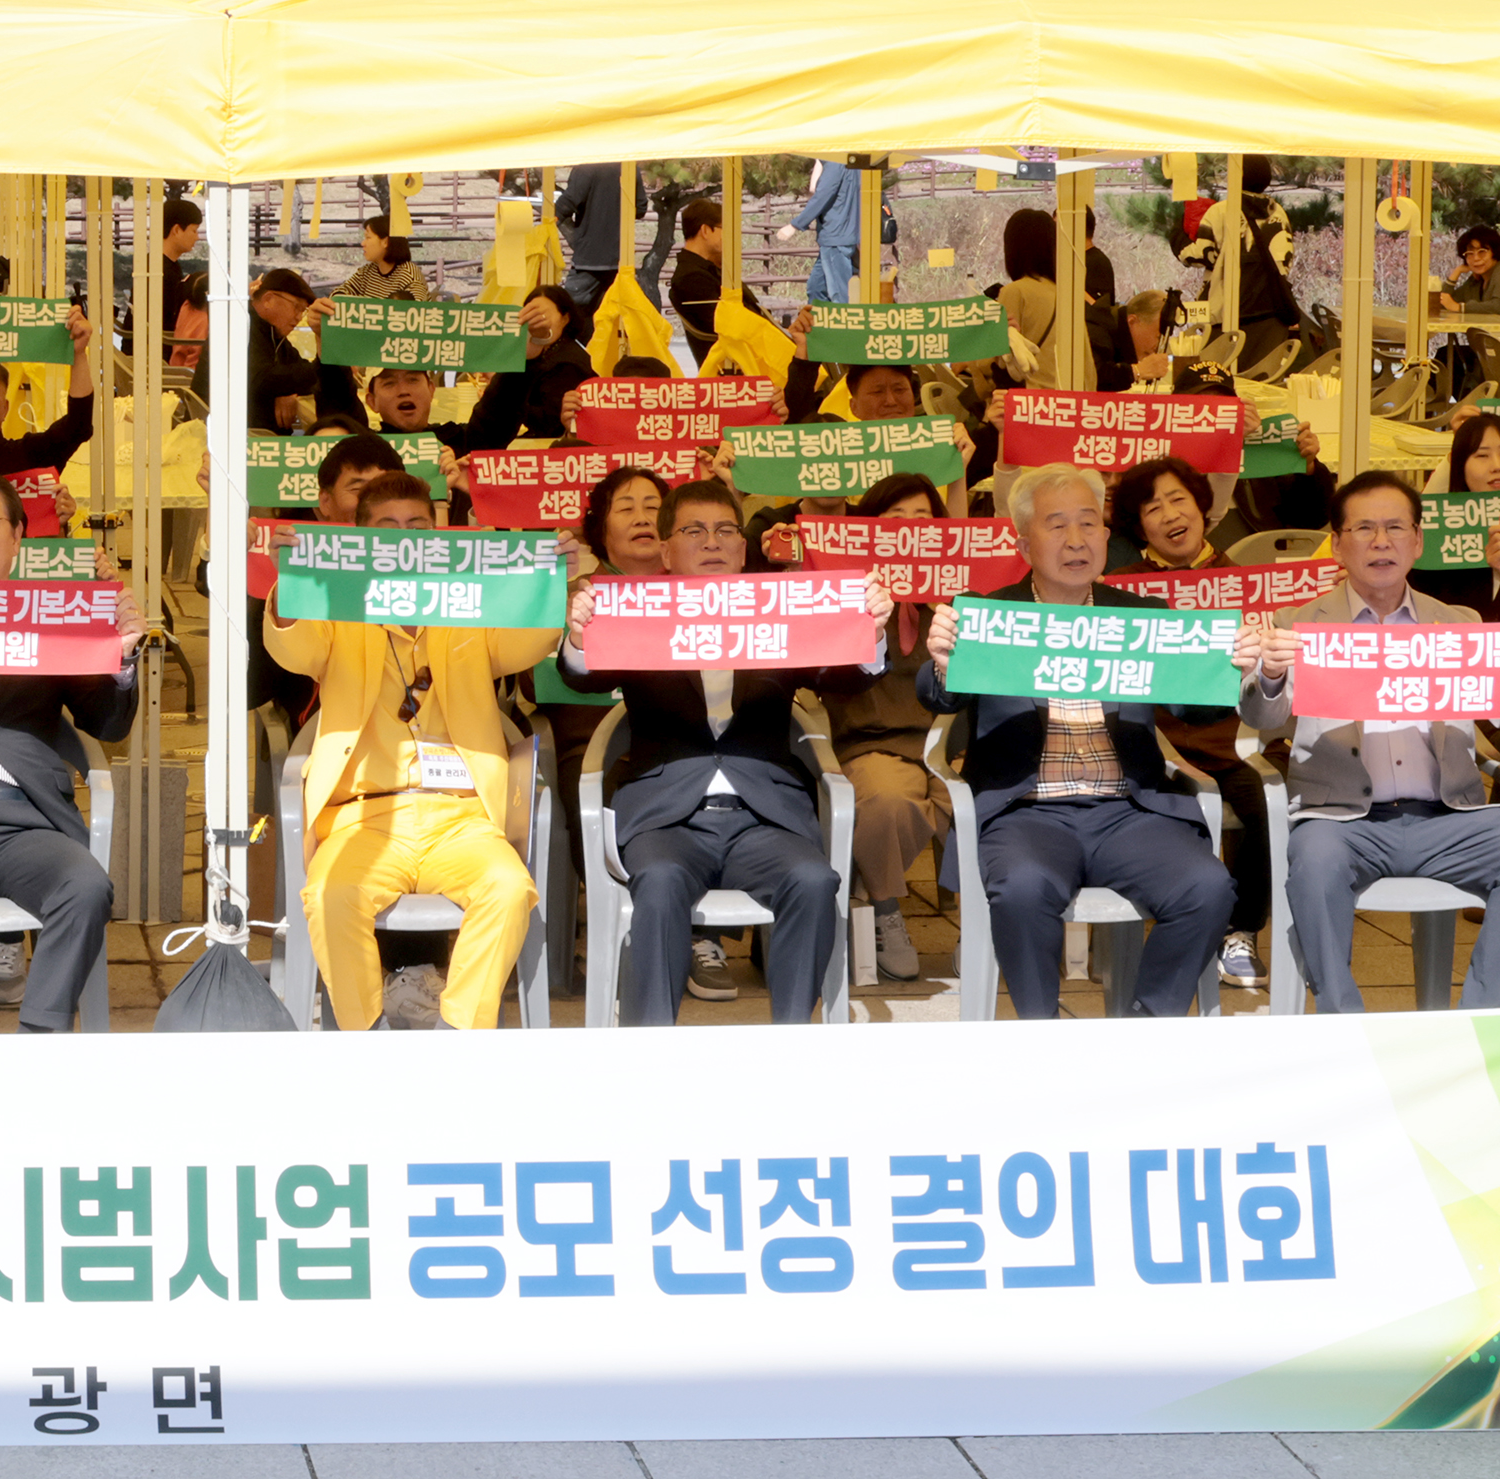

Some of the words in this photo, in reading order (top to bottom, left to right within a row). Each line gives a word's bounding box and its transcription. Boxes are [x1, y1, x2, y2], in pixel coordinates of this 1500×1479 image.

[0, 301, 69, 328] 기본소득
[327, 302, 384, 331] 괴산군
[387, 306, 444, 335] 농어촌
[447, 308, 521, 337] 기본소득
[812, 306, 865, 330] 괴산군
[868, 305, 925, 331] 농어촌
[927, 301, 1002, 328] 기본소득
[380, 337, 418, 364] 선정
[421, 340, 465, 367] 기원!
[865, 334, 903, 360] 선정
[906, 333, 949, 360] 기원!
[580, 383, 636, 409] 괴산군
[639, 382, 696, 409] 농어촌
[699, 380, 775, 407] 기본소득
[637, 415, 673, 440] 선정
[677, 414, 719, 440] 기원!
[1012, 395, 1077, 428] 괴산군
[1080, 399, 1146, 431] 농어촌
[1150, 402, 1239, 435] 기본소득
[246, 441, 280, 468] 산군
[284, 442, 334, 468] 농어
[392, 437, 440, 465] 소득
[730, 430, 796, 458] 괴산군
[799, 426, 864, 456] 농어촌
[869, 419, 955, 453] 기본소득
[1073, 435, 1116, 465] 선정
[474, 455, 539, 485] 괴산군
[543, 453, 607, 484] 농어촌
[798, 462, 841, 491] 선정
[278, 473, 320, 501] 선정
[538, 491, 581, 520] 선정
[288, 534, 366, 570] 괴산군
[371, 536, 450, 574] 농어촌
[456, 539, 559, 575] 기본소득
[801, 522, 870, 556] 괴산군
[873, 525, 943, 558] 농어촌
[947, 526, 1019, 558] 기본소
[1440, 534, 1484, 563] 선정
[9, 547, 96, 578] 기본소득
[873, 563, 913, 596] 선정
[918, 565, 969, 596] 기원!
[364, 580, 417, 616] 선정
[422, 581, 482, 618] 기원!
[594, 582, 671, 617] 괴산군
[676, 581, 755, 617] 농어촌
[761, 578, 866, 615] 기본소득
[1174, 574, 1243, 610] 농어촌
[1248, 566, 1339, 605] 기본소득
[13, 588, 116, 625] 기본소득
[670, 624, 722, 661] 선정
[728, 623, 788, 660] 기원!
[959, 607, 1040, 647] 괴산군
[1044, 613, 1125, 652] 농어촌
[1129, 618, 1237, 656] 기본소득
[1303, 633, 1378, 668] 괴산군
[1384, 632, 1462, 668] 농어촌
[1033, 655, 1087, 693] 선정
[1092, 659, 1154, 695] 기원!
[1377, 676, 1428, 712] 선정
[1435, 676, 1493, 711] 기원!
[406, 1160, 616, 1299] 공모
[650, 1156, 855, 1295] 선정
[889, 1151, 1097, 1290] 결의
[1127, 1141, 1338, 1285] 대회
